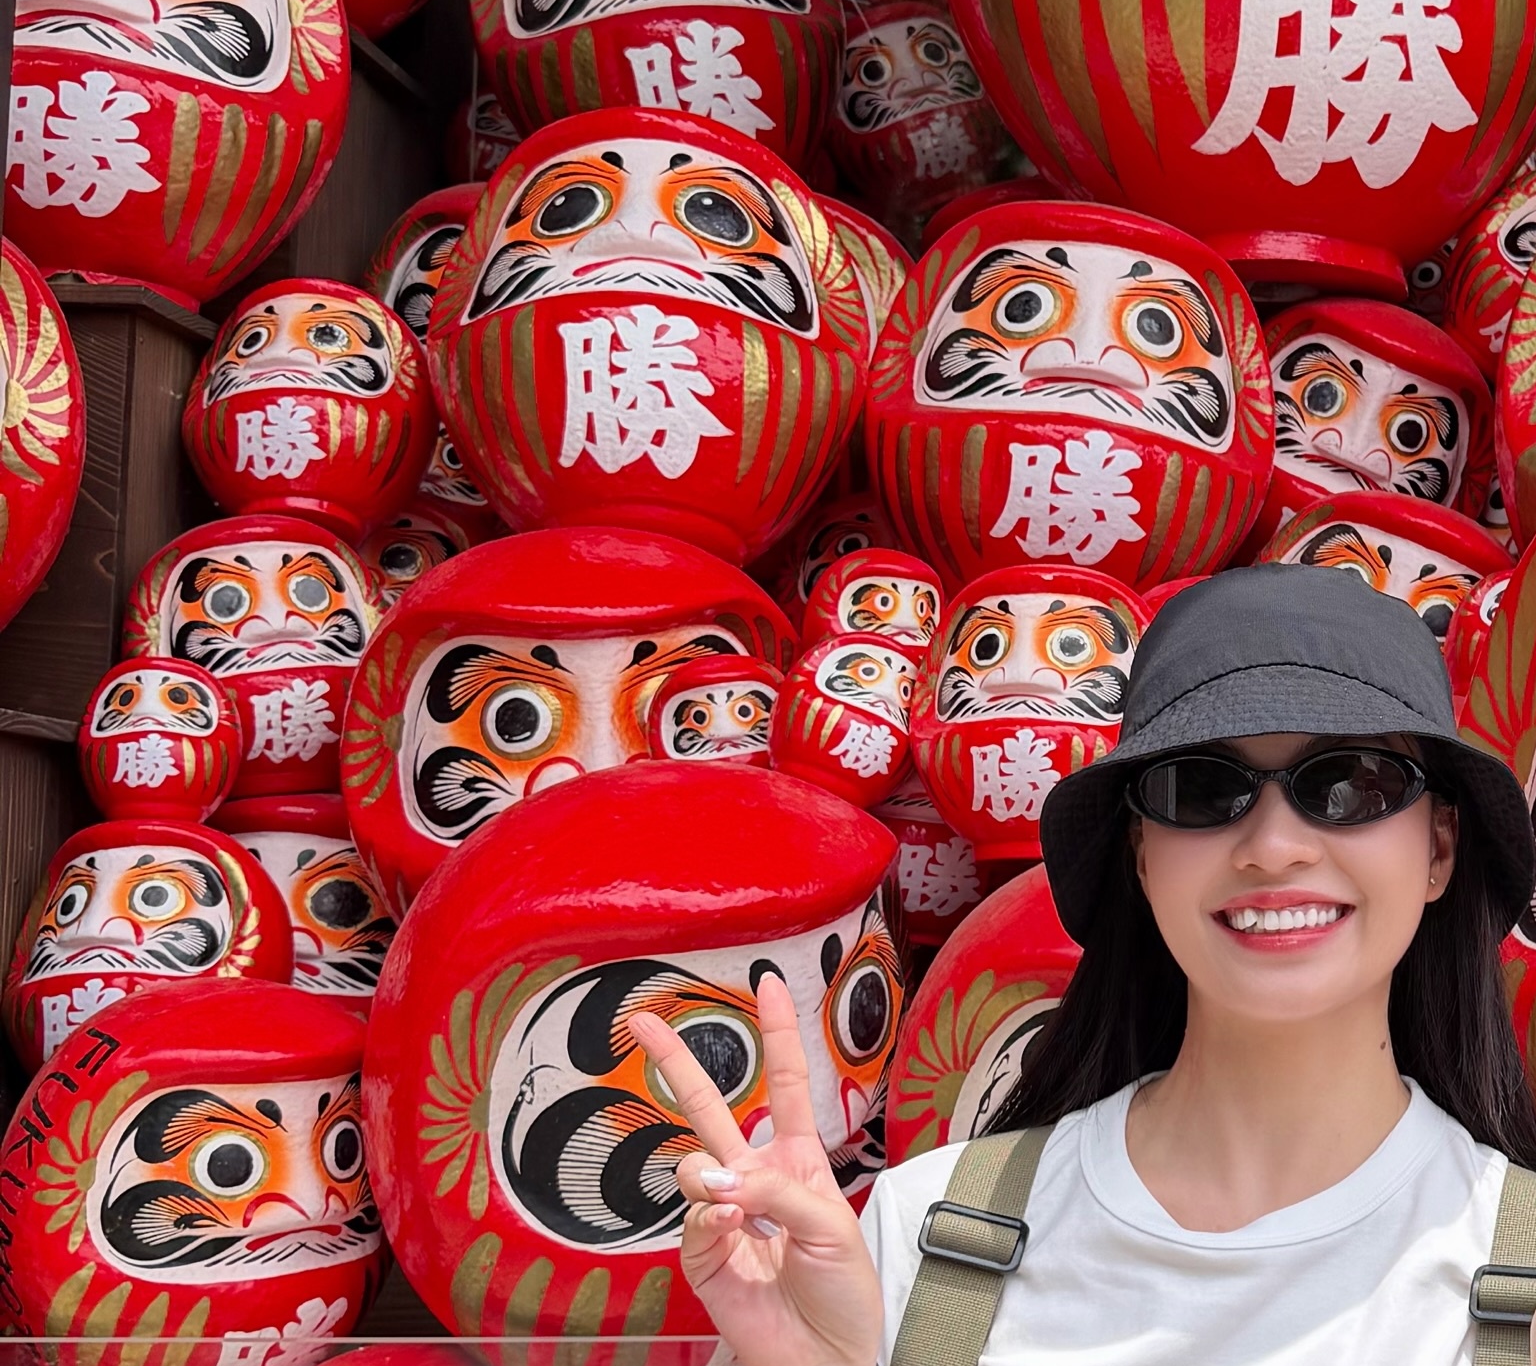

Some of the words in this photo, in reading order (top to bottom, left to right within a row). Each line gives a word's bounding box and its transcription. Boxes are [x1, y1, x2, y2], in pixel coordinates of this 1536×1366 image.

[625, 19, 776, 140] 勝
[4, 70, 162, 217] 勝
[907, 112, 979, 178] 勝
[557, 304, 735, 480] 勝
[235, 396, 327, 480] 勝
[991, 431, 1147, 566] 勝
[112, 733, 180, 788] 勝
[247, 677, 340, 764] 勝
[828, 718, 899, 778] 勝
[970, 728, 1060, 822] 勝
[898, 836, 982, 917] 勝
